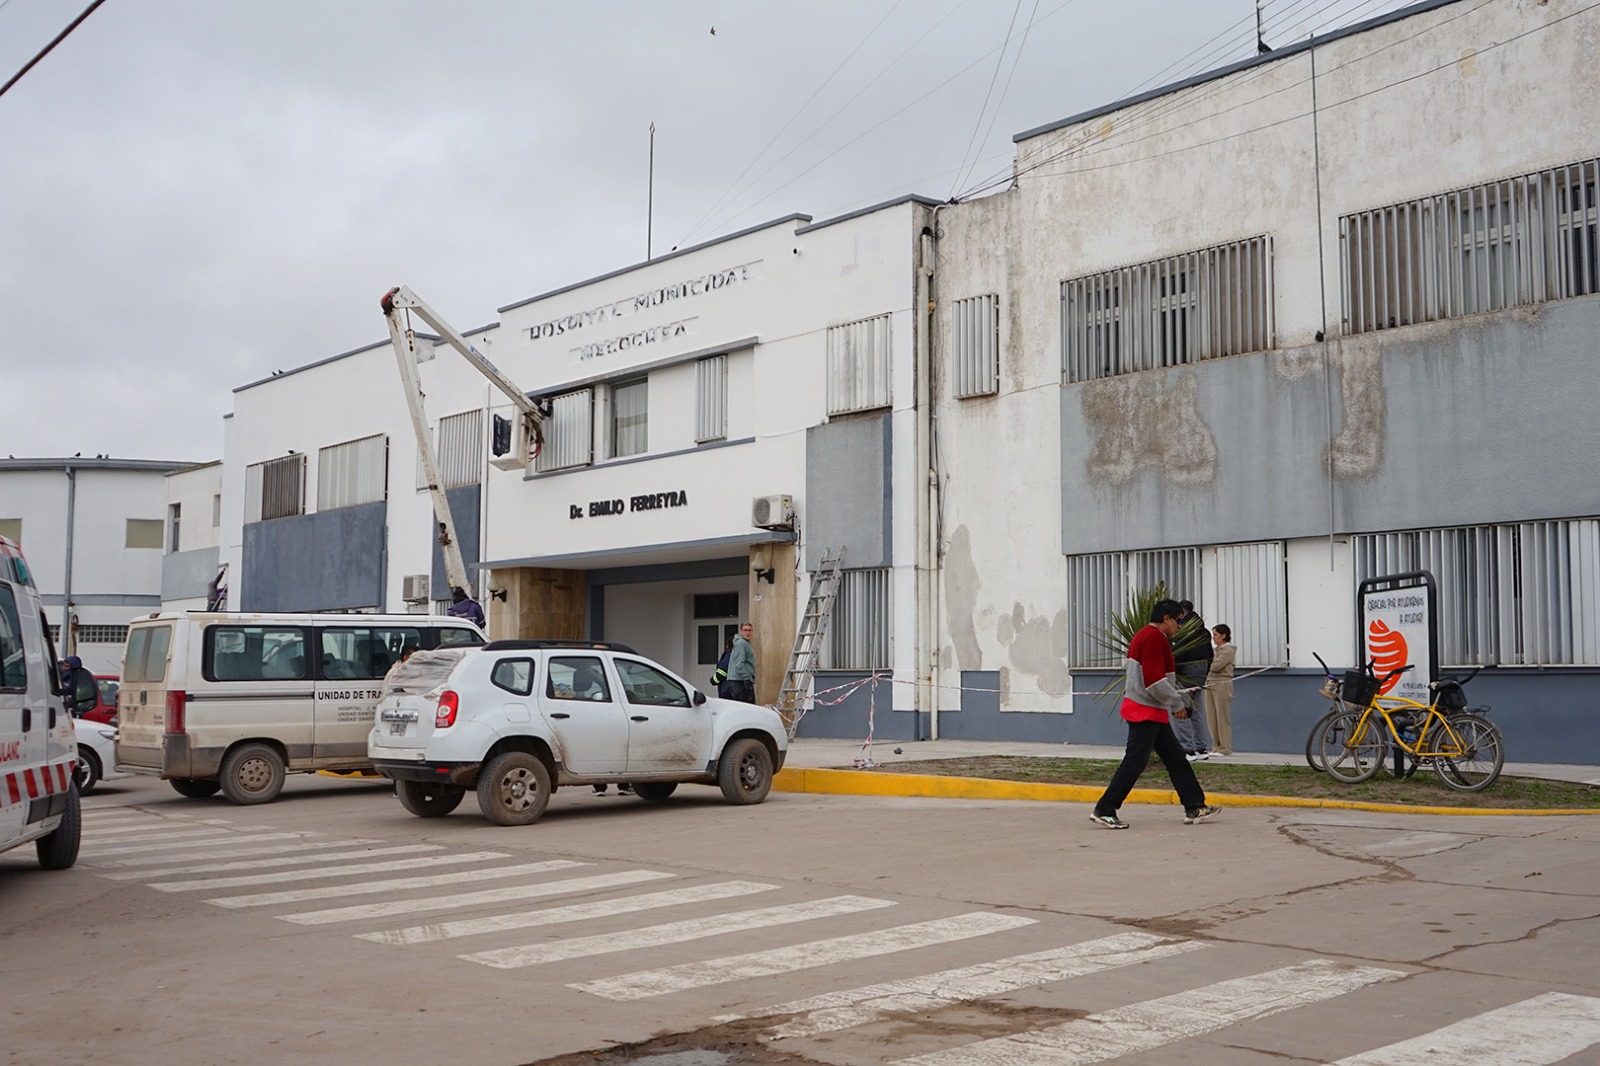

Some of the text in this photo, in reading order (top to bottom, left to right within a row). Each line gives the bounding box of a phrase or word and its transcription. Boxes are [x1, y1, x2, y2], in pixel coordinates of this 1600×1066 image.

[589, 499, 624, 517] EMILIO
[630, 490, 687, 512] FERREYRA
[318, 690, 350, 700] UNIDAD
[353, 690, 364, 699] DE
